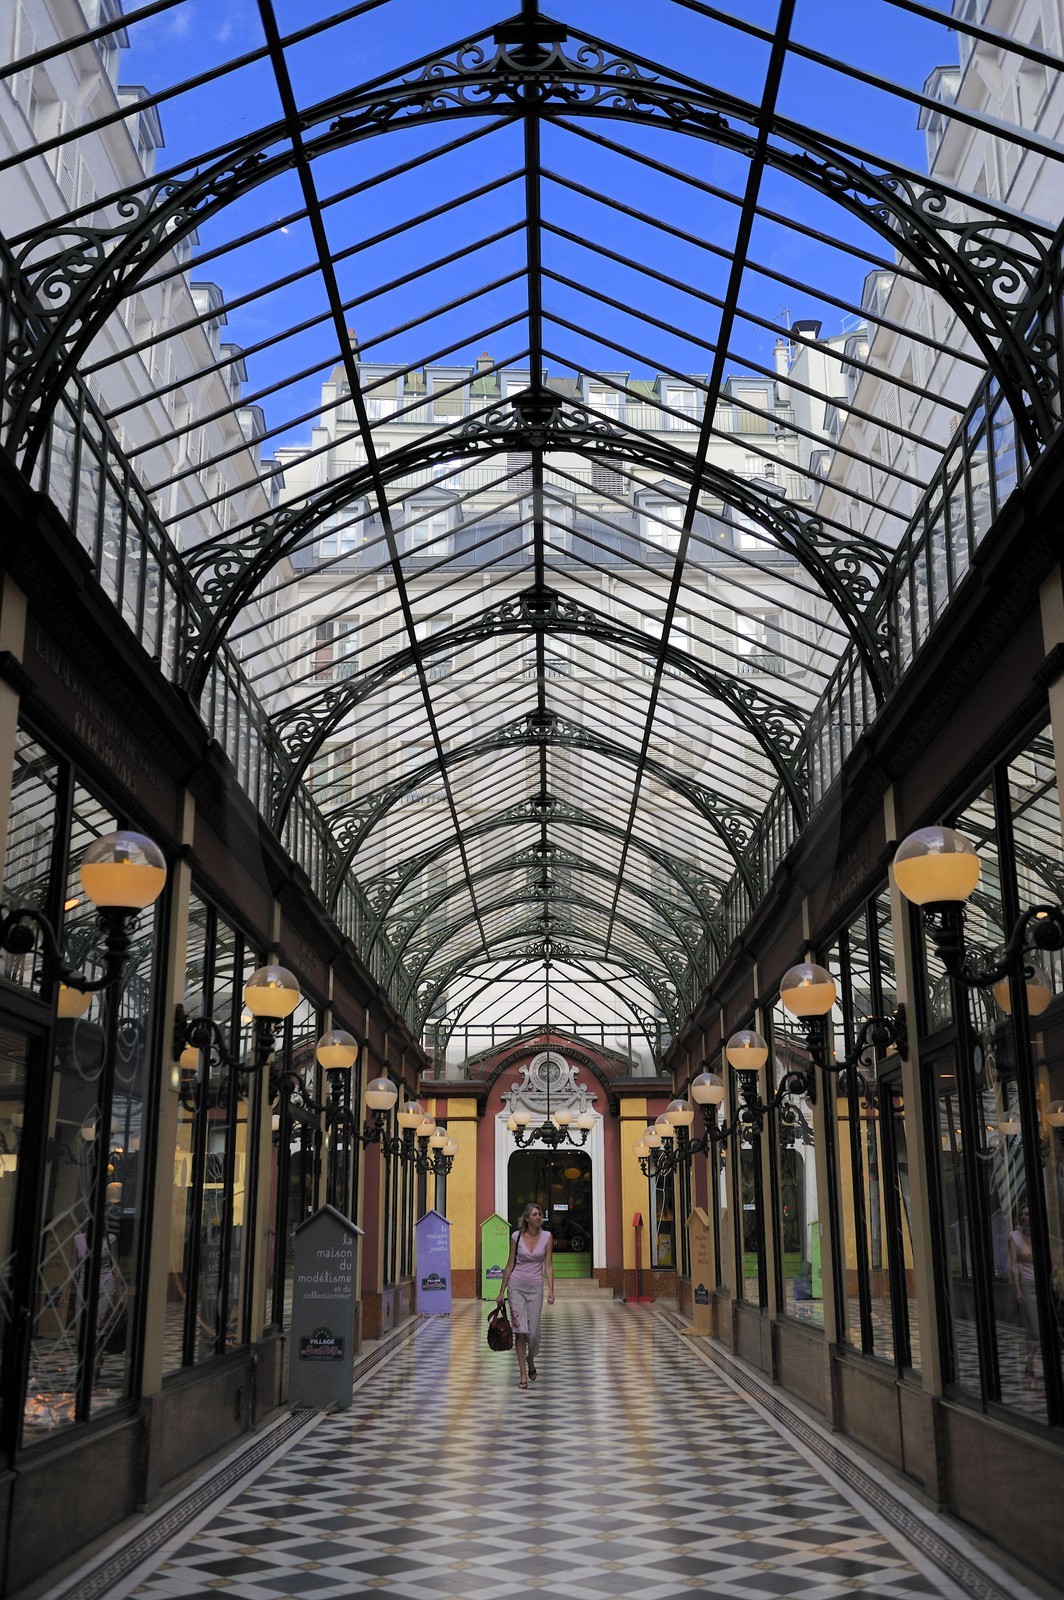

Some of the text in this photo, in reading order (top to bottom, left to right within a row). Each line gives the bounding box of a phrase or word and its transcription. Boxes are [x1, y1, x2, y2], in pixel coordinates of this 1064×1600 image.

[342, 1233, 352, 1245] la
[317, 1248, 352, 1258] maison
[429, 1246, 448, 1254] jouets
[340, 1258, 352, 1270] du
[298, 1271, 351, 1283] modélisme
